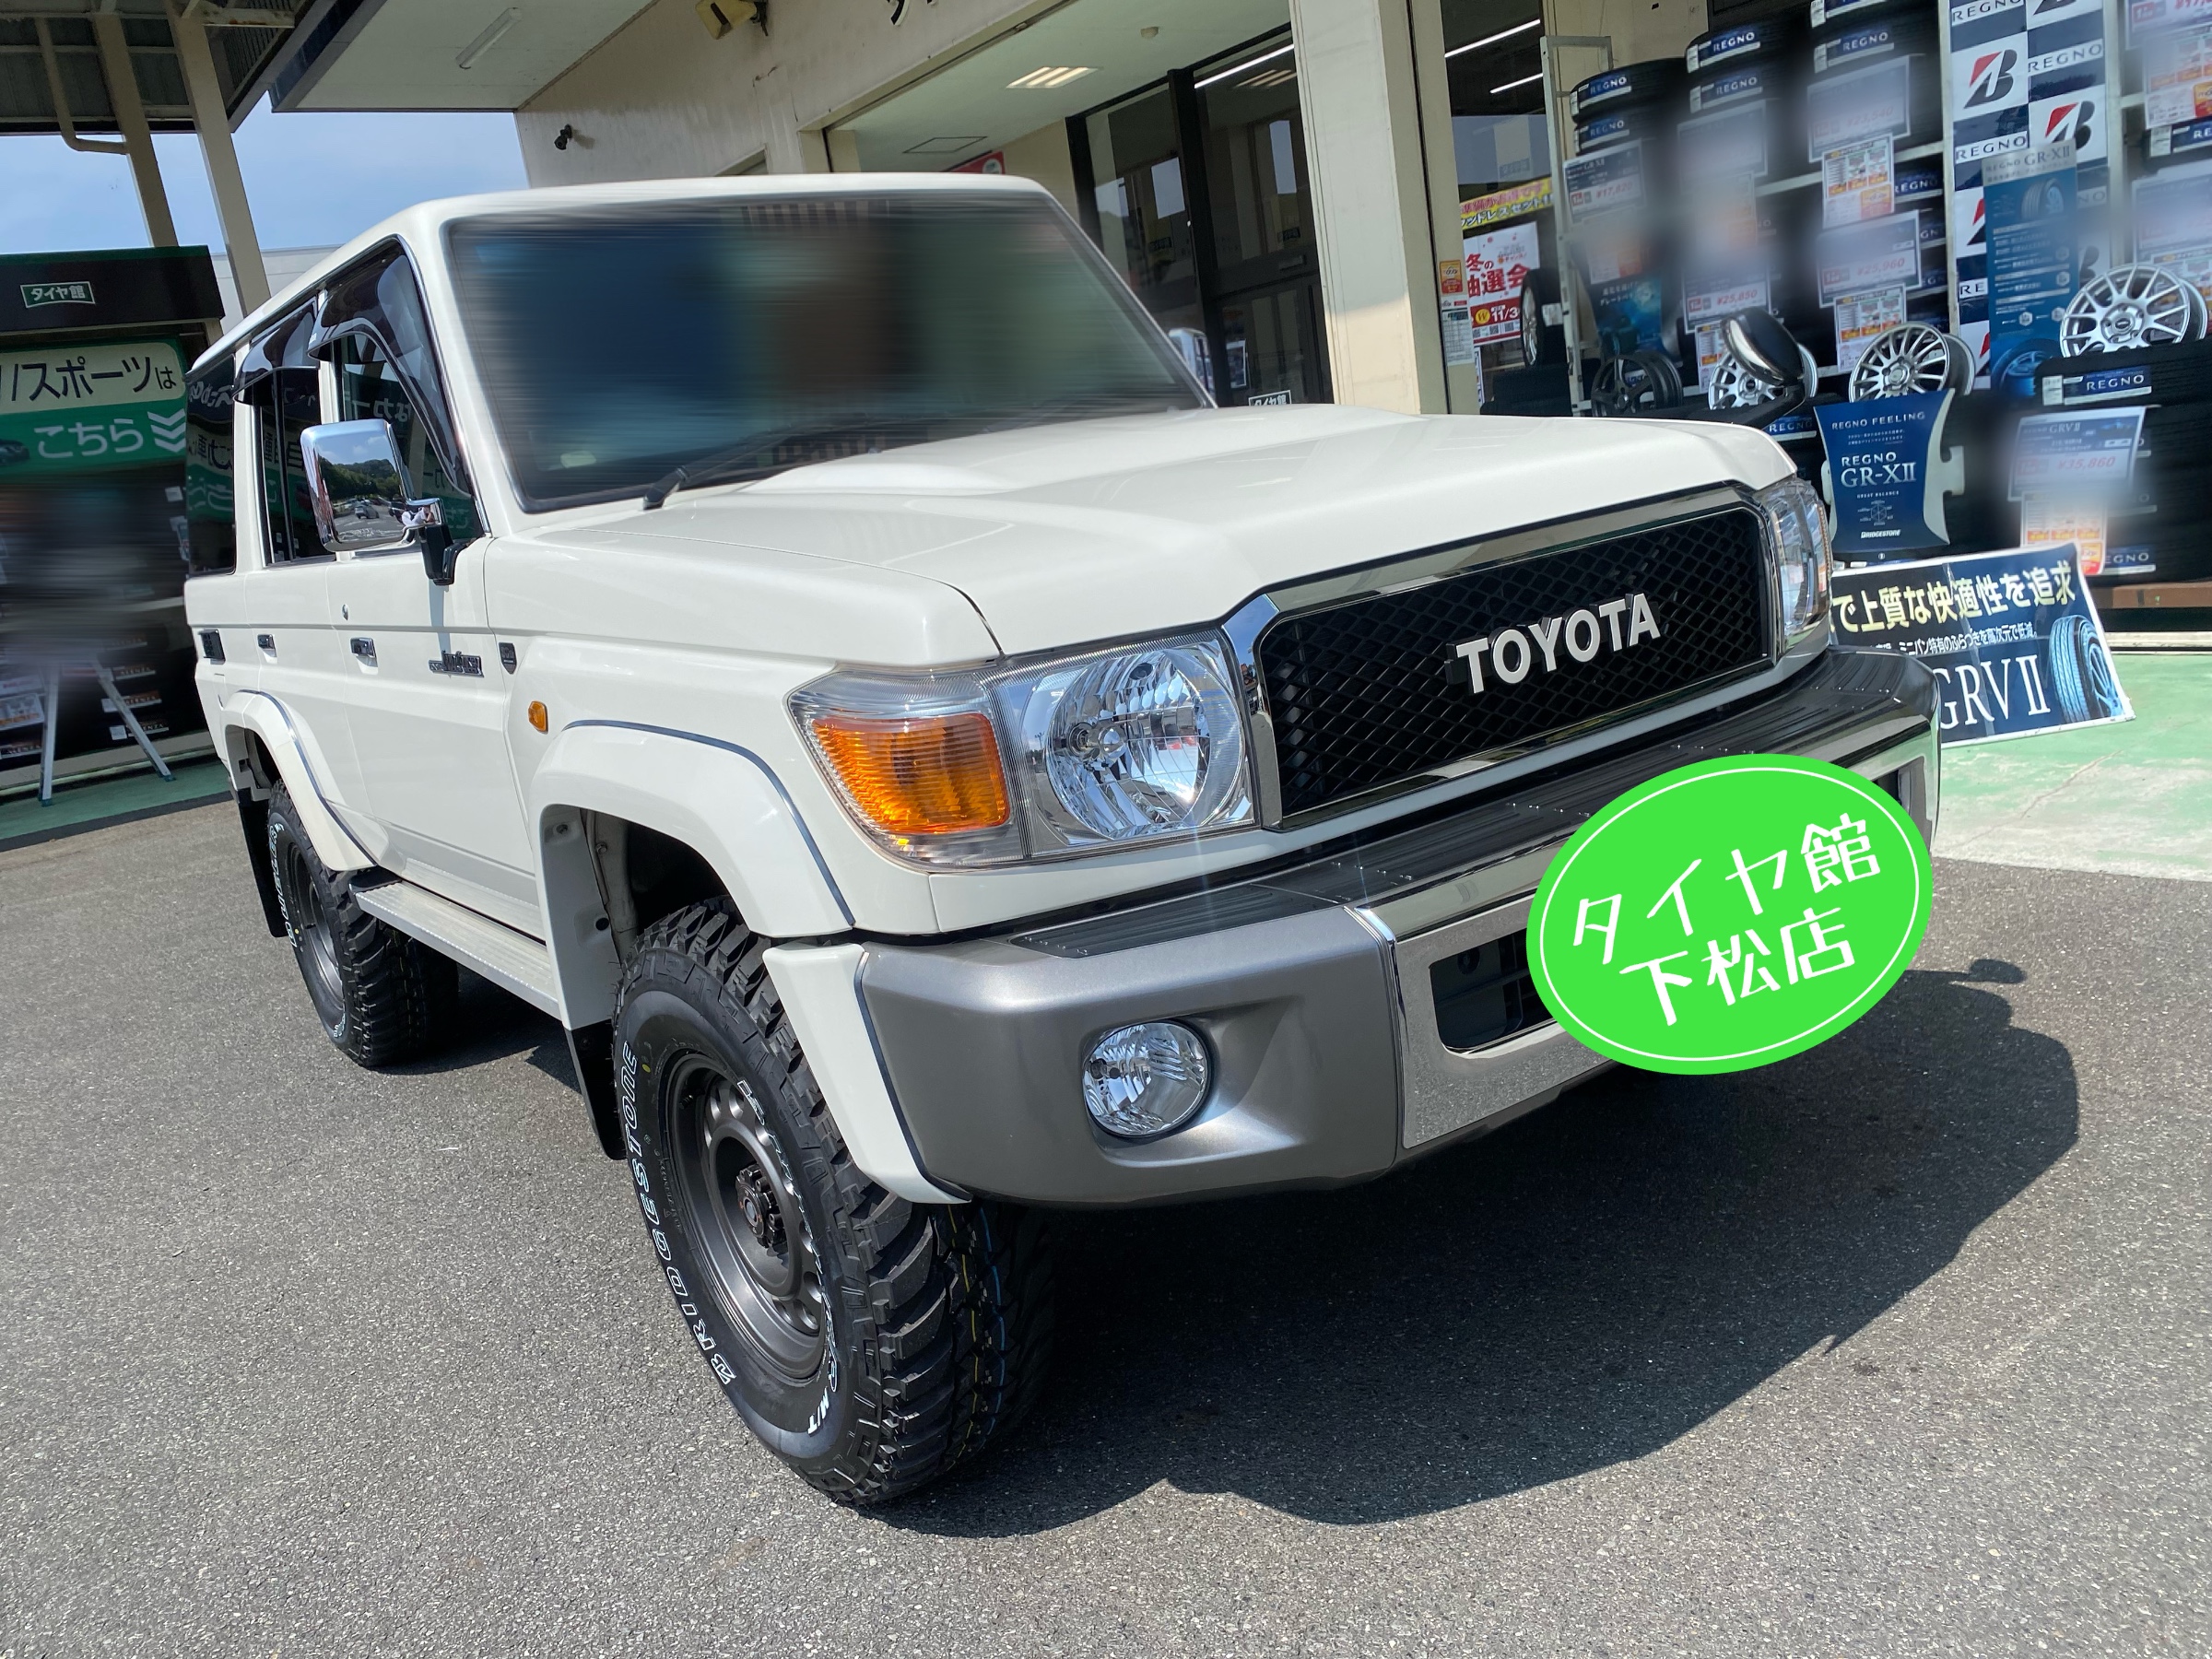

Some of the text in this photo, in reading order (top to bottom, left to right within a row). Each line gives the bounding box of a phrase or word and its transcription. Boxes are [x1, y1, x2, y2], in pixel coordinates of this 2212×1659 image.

[1712, 31, 1756, 52] REGNO
[1843, 31, 1888, 51] REGNO
[2028, 43, 2102, 73] REGNO
[1590, 76, 1628, 95] REGNO
[1715, 76, 1759, 95] REGNO
[1590, 120, 1625, 136] REGNO
[1954, 135, 2027, 161] REGNO
[30, 284, 87, 301] タイヤ館
[2086, 373, 2145, 392] REGNO
[1769, 420, 1813, 433] REGNO
[1831, 411, 1926, 430] REGNO FEELING
[33, 418, 144, 459] こちら
[1841, 452, 1897, 467] REGNO
[1856, 489, 1900, 500] GREAT BALANCE
[1860, 528, 1901, 539] BRIDGESTONE
[2104, 552, 2149, 565] EGNO
[1830, 559, 2077, 634] で上質な快適性を追求
[1452, 593, 1661, 694] TOYOTA
[619, 1040, 737, 1384] BRIDGESTONE
